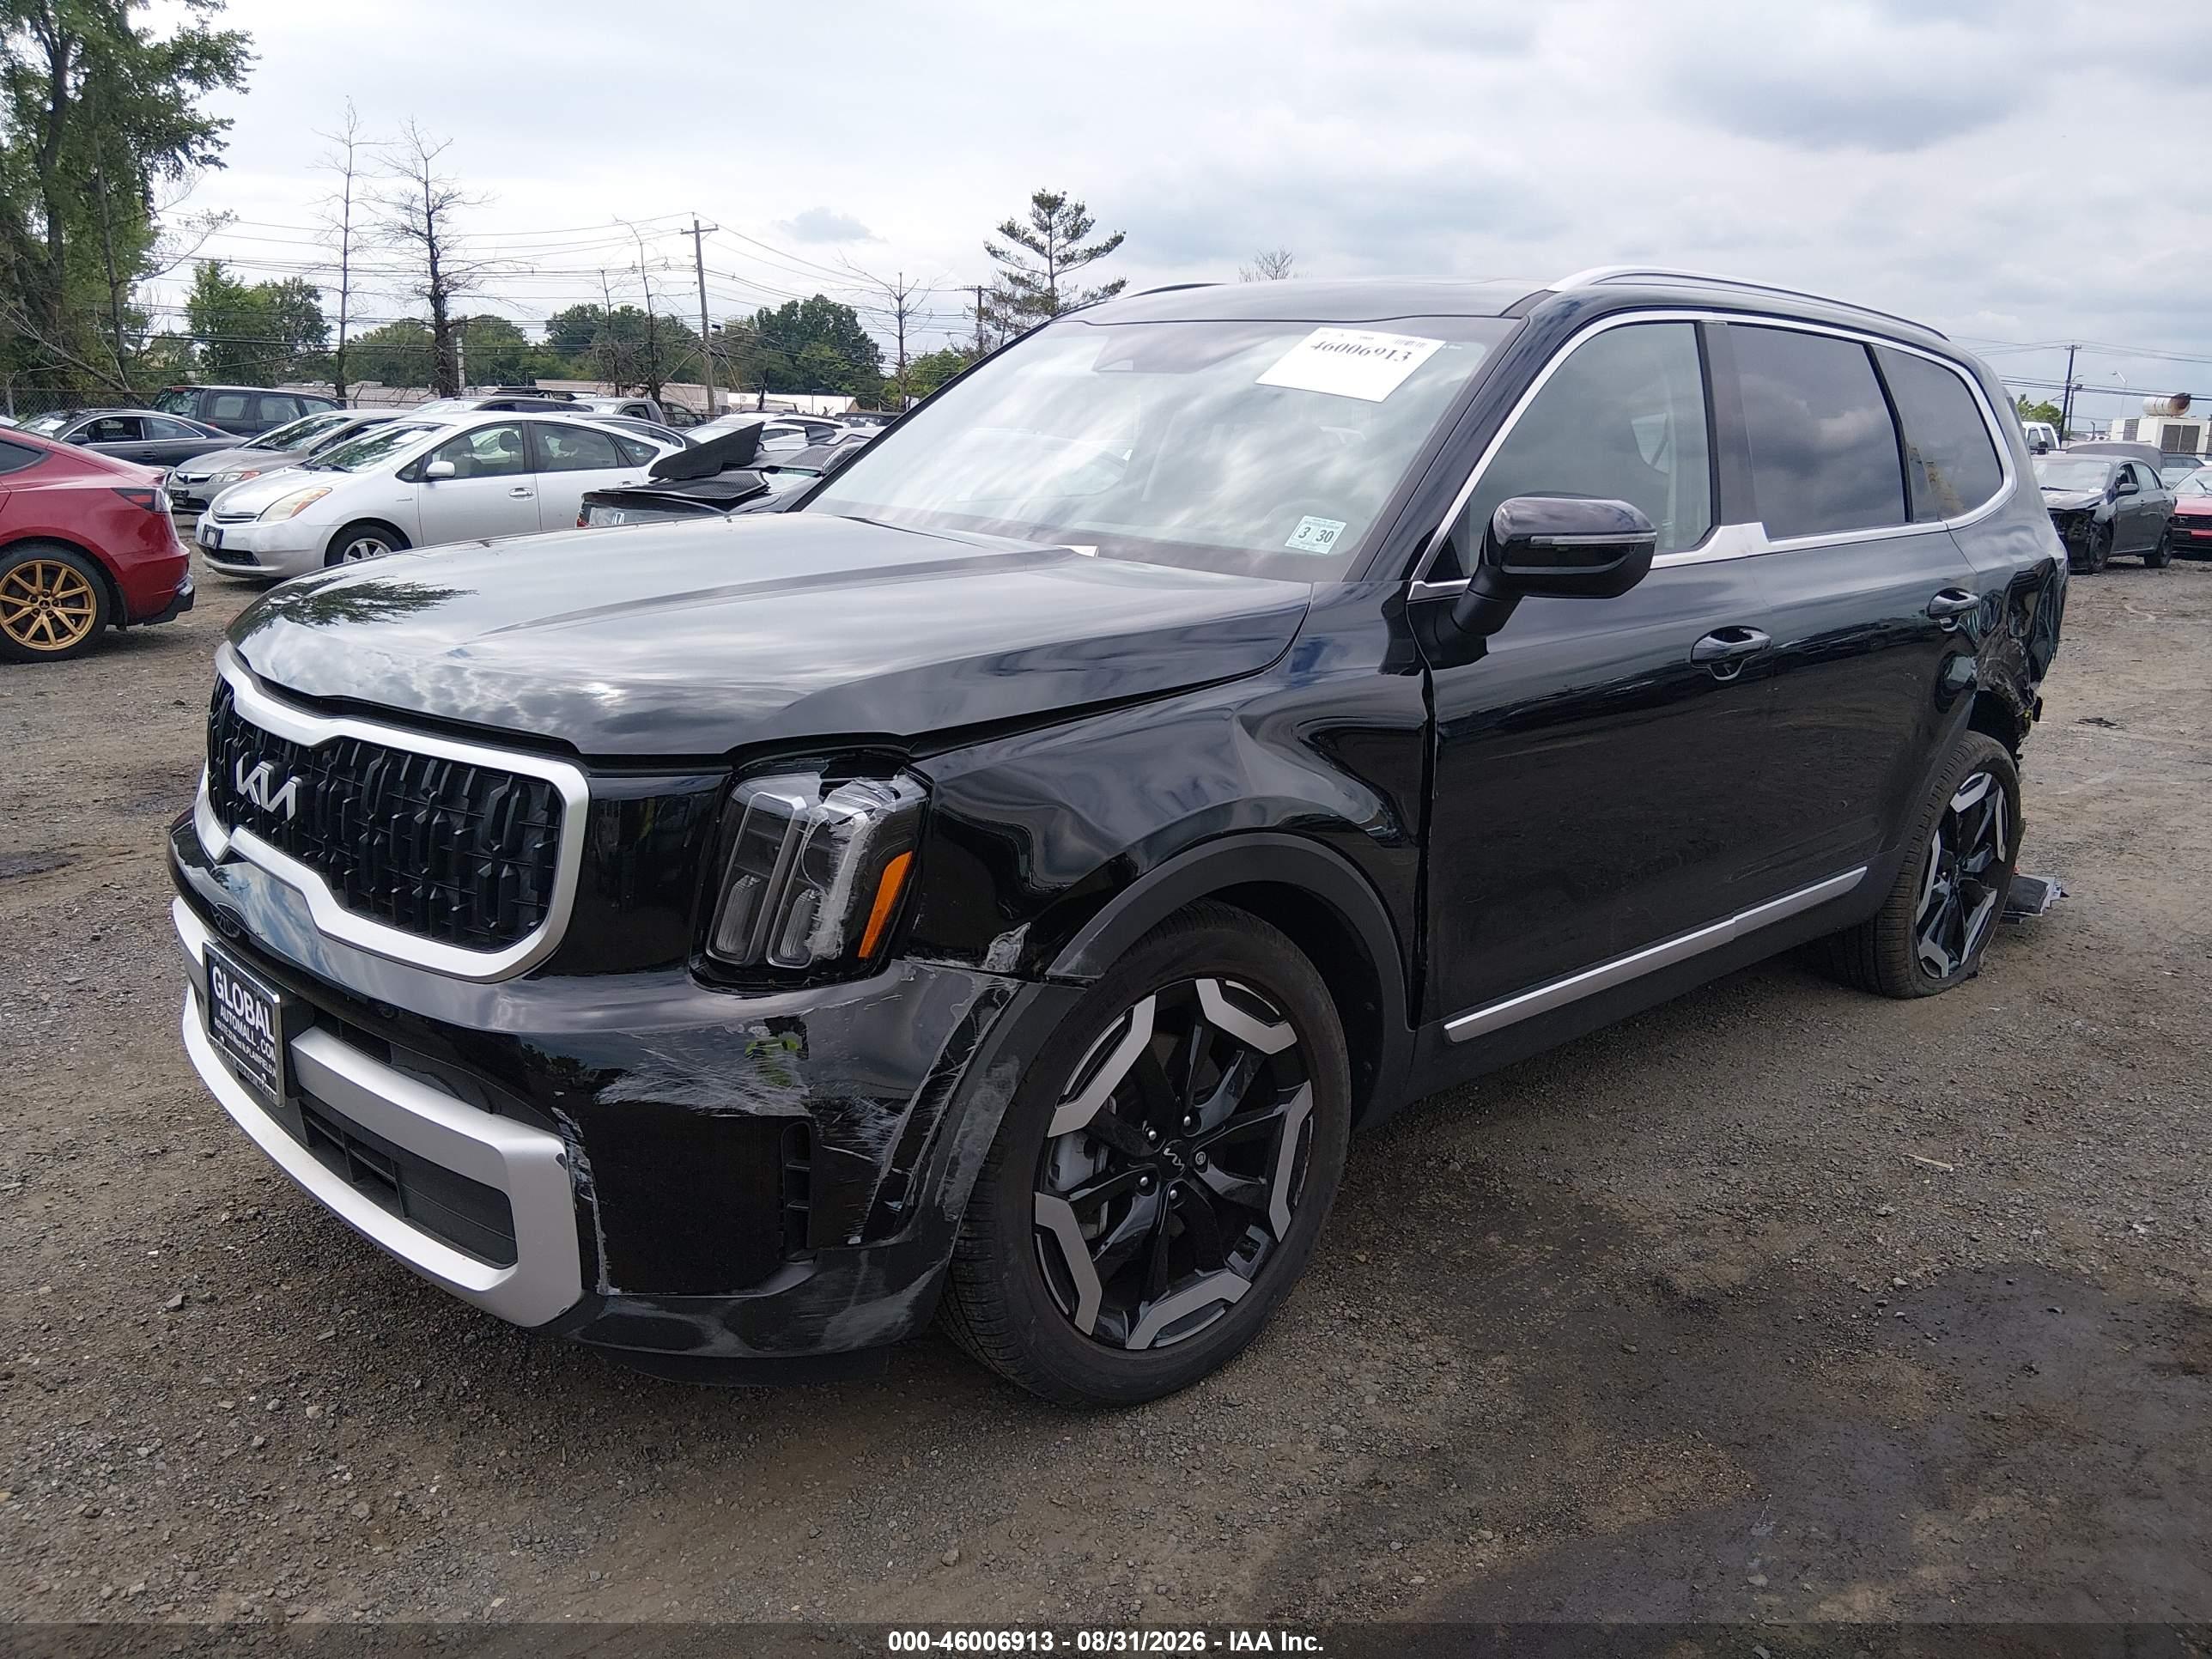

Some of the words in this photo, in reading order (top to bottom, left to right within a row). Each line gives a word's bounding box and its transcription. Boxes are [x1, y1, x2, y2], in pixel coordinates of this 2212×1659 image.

[1310, 340, 1413, 362] 46006913
[1298, 526, 1311, 538] 3
[1316, 529, 1334, 543] 30
[236, 751, 301, 821] KIA
[212, 965, 275, 1044] GLOBAL
